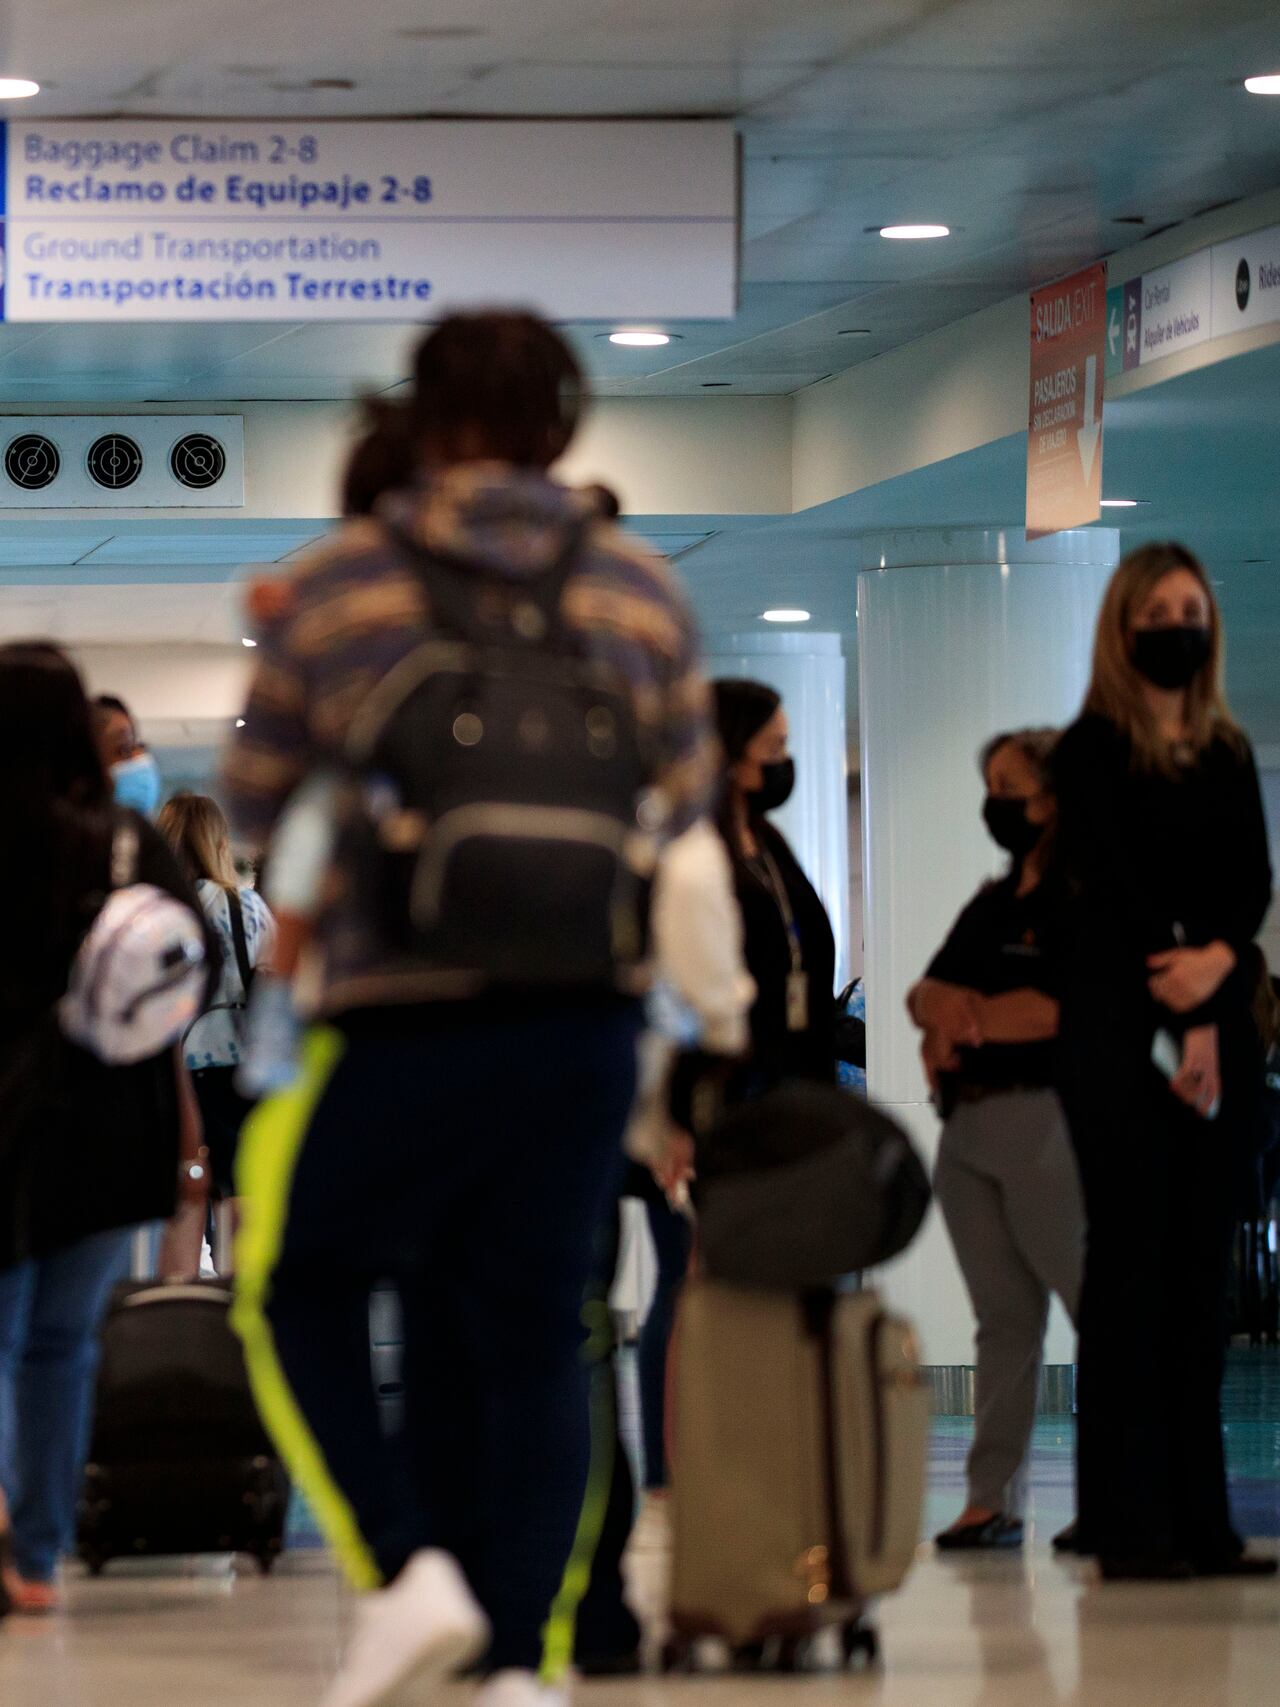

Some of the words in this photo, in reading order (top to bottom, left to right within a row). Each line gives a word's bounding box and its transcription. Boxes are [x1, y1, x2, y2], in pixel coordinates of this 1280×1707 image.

[25, 134, 161, 169] Baggage
[170, 134, 259, 163] Claim
[270, 135, 317, 164] 2-8
[26, 175, 166, 202] Reclamo
[175, 175, 216, 202] de
[226, 175, 370, 208] Equipaje
[381, 176, 432, 202] 2-8
[24, 232, 142, 261] Ground
[153, 233, 381, 265] Transportation
[26, 270, 275, 305] Transportación
[286, 272, 432, 299] Terrestre
